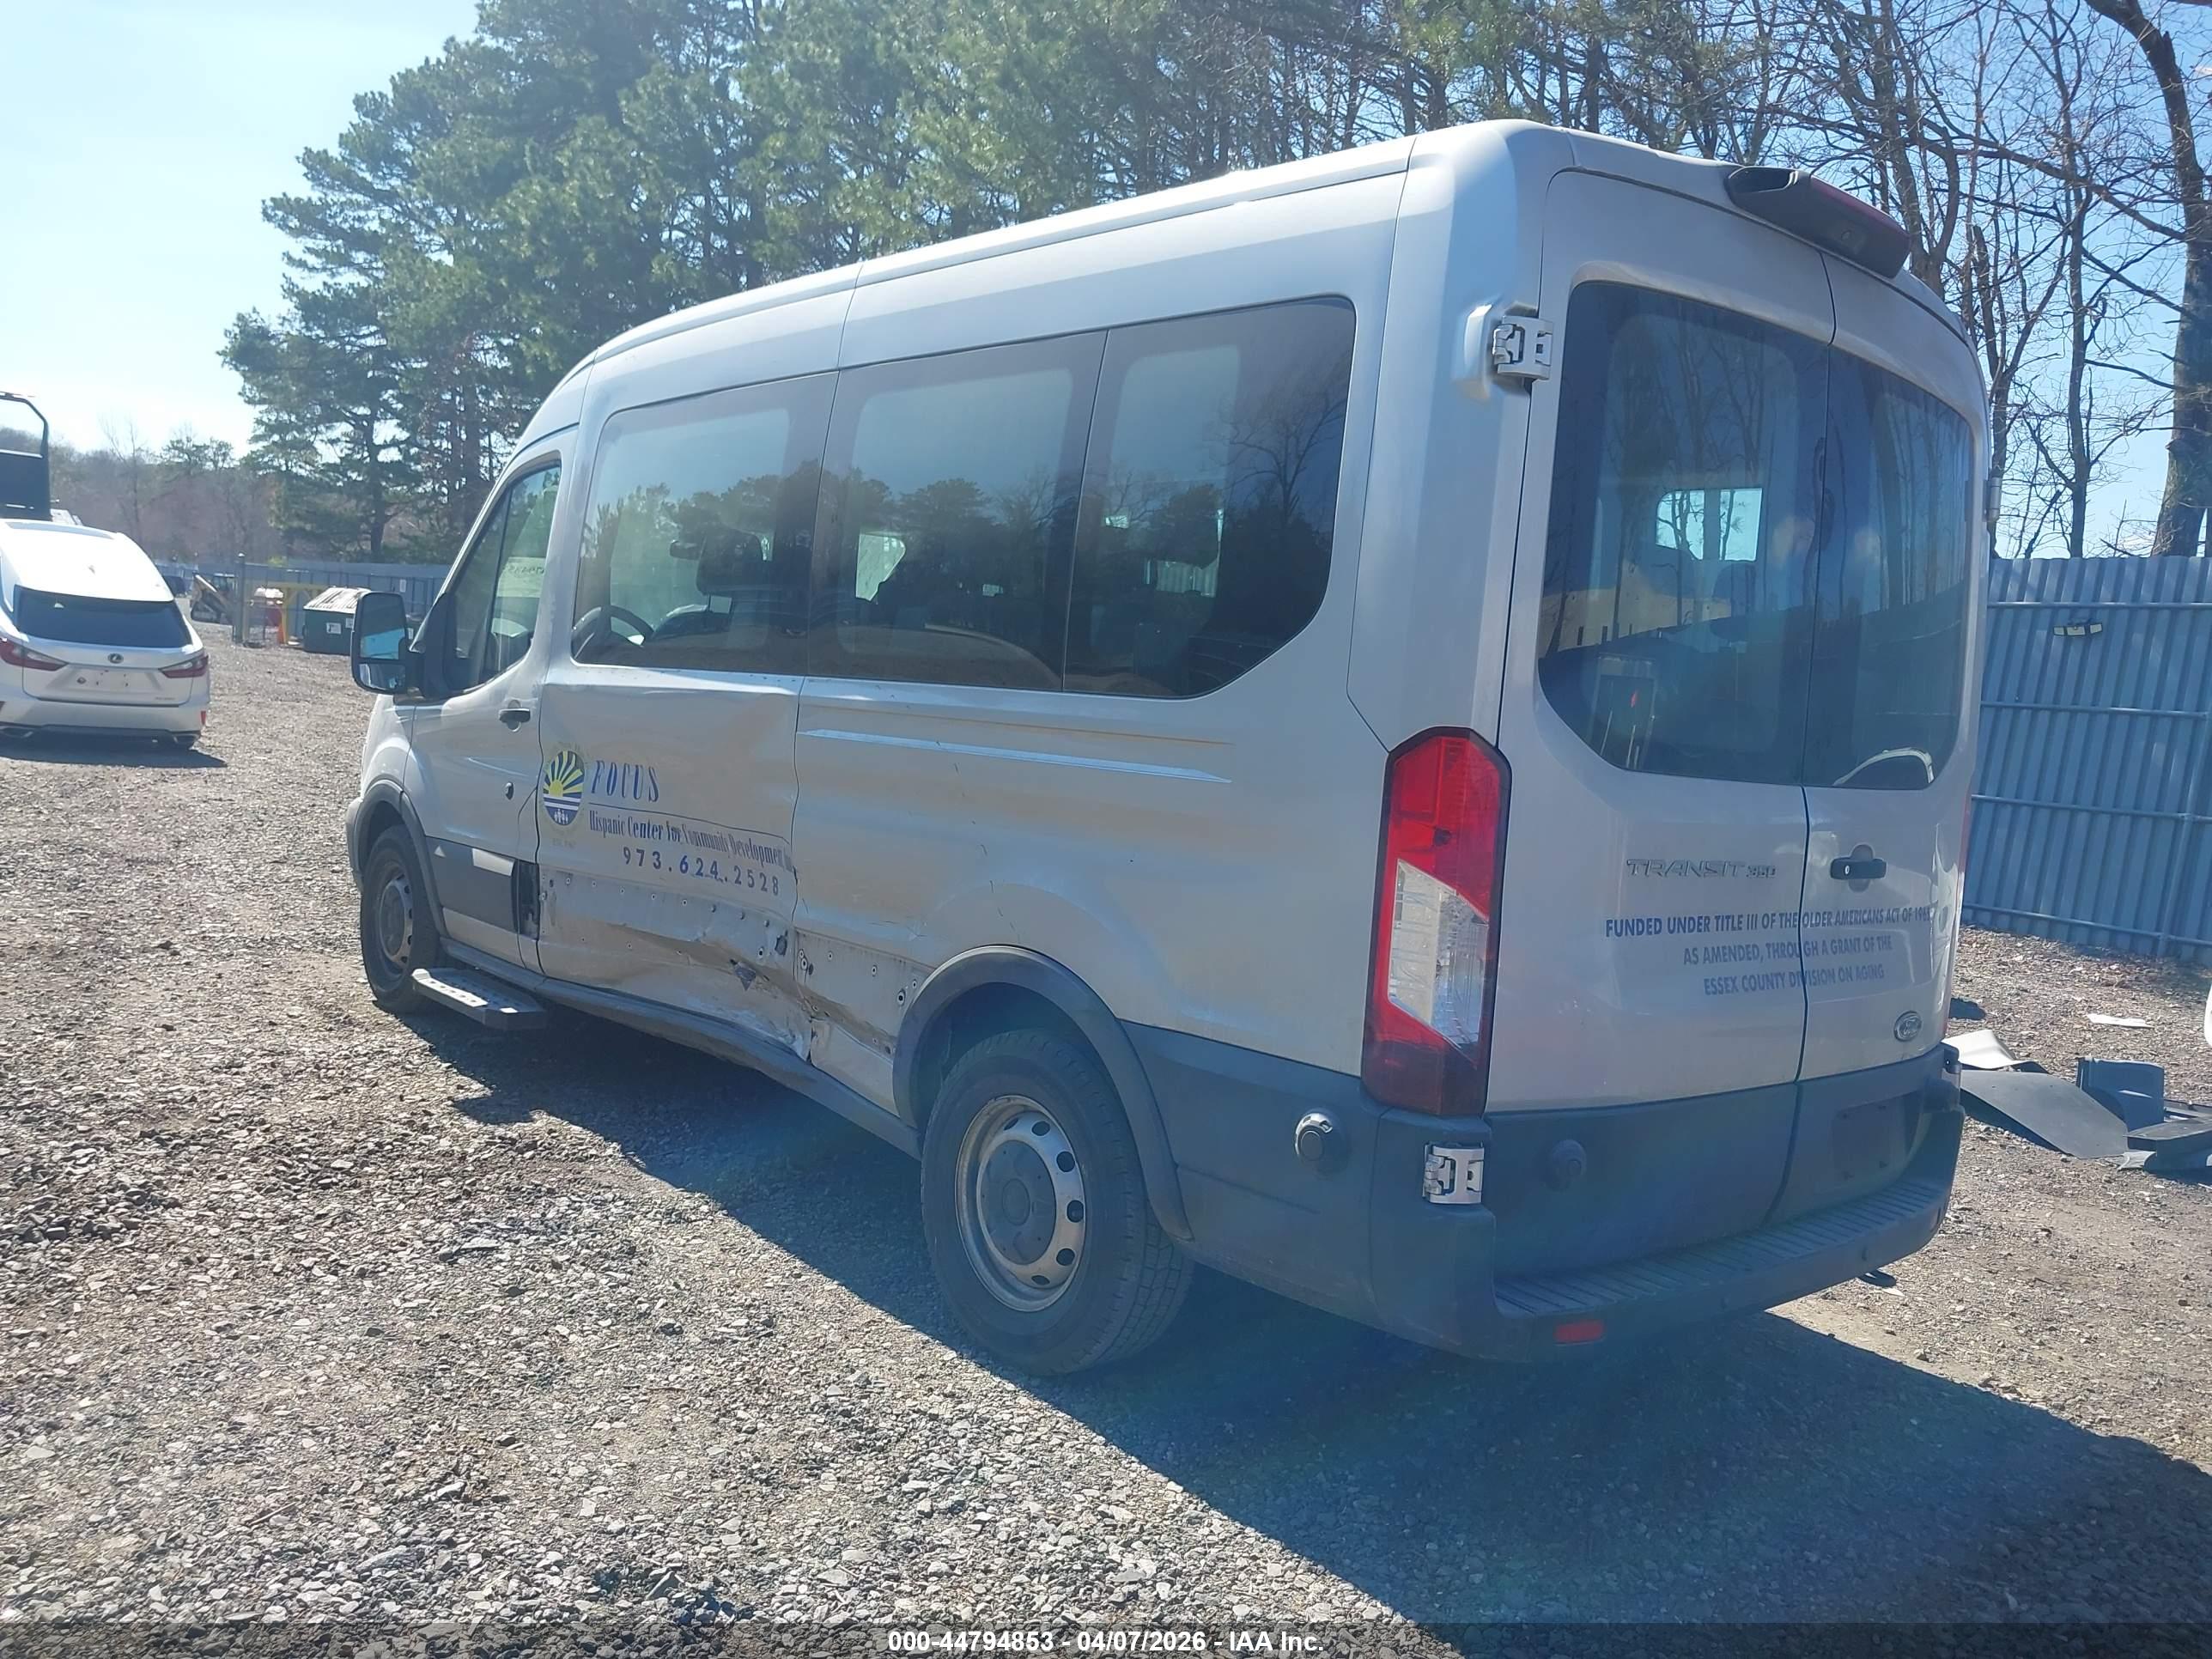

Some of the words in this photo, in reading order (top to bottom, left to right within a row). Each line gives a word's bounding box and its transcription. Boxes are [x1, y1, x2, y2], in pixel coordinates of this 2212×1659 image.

[591, 760, 659, 803] FOCUS
[589, 810, 626, 838] Hispanic
[628, 816, 664, 841] Center
[665, 820, 682, 842] for
[623, 846, 779, 896] 973.624.2528
[1626, 859, 1745, 878] TRANSIT
[1605, 917, 1662, 938] FUNDED
[1667, 915, 1711, 934] UNDER
[1714, 914, 1744, 933] TITLE
[1747, 913, 1759, 931] III
[1761, 913, 1777, 930] OF
[1778, 912, 1798, 929] THE
[1803, 910, 1832, 928] OLDER
[1834, 908, 1884, 927] AMERICANS
[1885, 908, 1900, 924] ACT
[1902, 907, 1913, 922] OF
[1683, 947, 1699, 966] AS
[1703, 944, 1764, 964] AMENDED,
[1765, 940, 1819, 960] THROUGH
[1821, 939, 1829, 956] A
[1830, 938, 1862, 955] GRANT
[1863, 936, 1875, 952] OF
[1875, 935, 1893, 951] THE
[1704, 975, 1740, 996] ESSEX
[1741, 971, 1785, 993] COUNTY
[1788, 967, 1836, 988] DIVISION
[1838, 966, 1853, 983] ON
[1855, 963, 1885, 981] AGING
